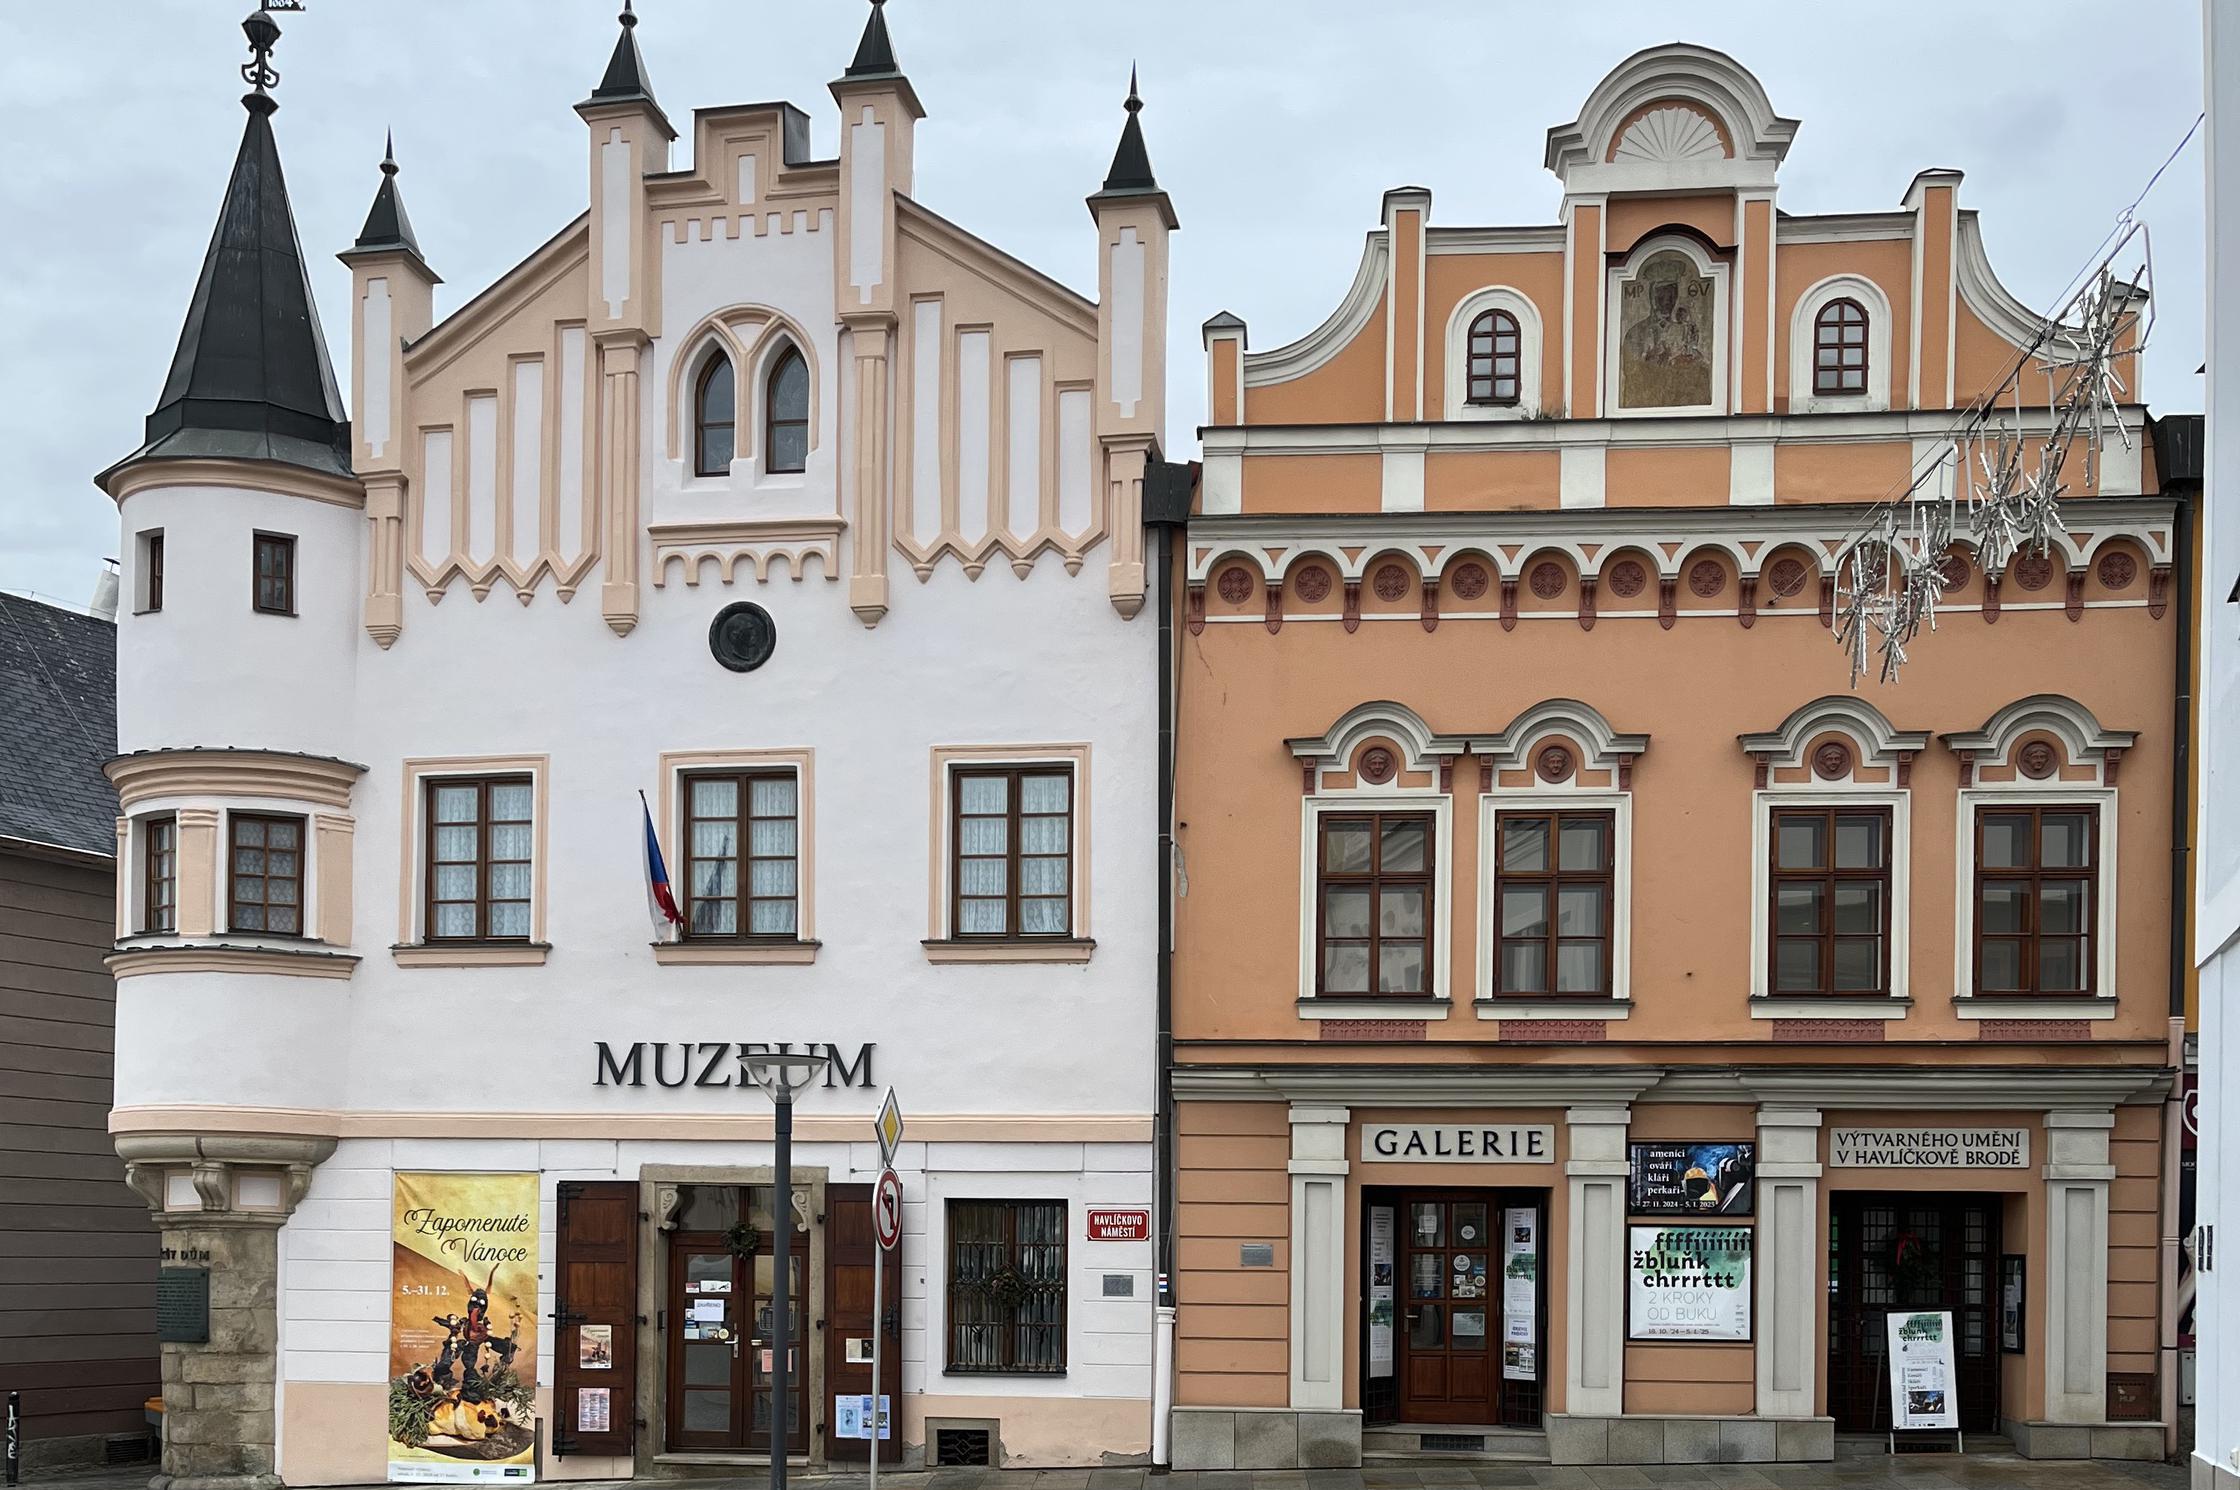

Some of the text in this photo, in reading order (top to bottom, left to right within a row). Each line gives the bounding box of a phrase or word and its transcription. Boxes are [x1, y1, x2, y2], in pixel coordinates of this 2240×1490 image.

[592, 1041, 877, 1088] MUZEUM
[1374, 1129, 1544, 1157] GALERIE
[1837, 1130, 2021, 1148] VÝTVARNÉHO UMĚNÍ
[1837, 1147, 2021, 1165] V HAVLÍČKOVĚ BRODĚ
[404, 1208, 529, 1240] Zapomenuté
[1094, 1213, 1143, 1226] HAVLÍČKOVO
[1101, 1225, 1136, 1238] NÁMĚSTÍ
[440, 1237, 528, 1262] Vánoce
[1633, 1250, 1710, 1270] žbluňk
[1643, 1269, 1735, 1288] chrrrttt
[435, 1285, 450, 1296] 12.
[1648, 1291, 1714, 1304] 2 KROKY
[1647, 1306, 1717, 1321] OD BUKU
